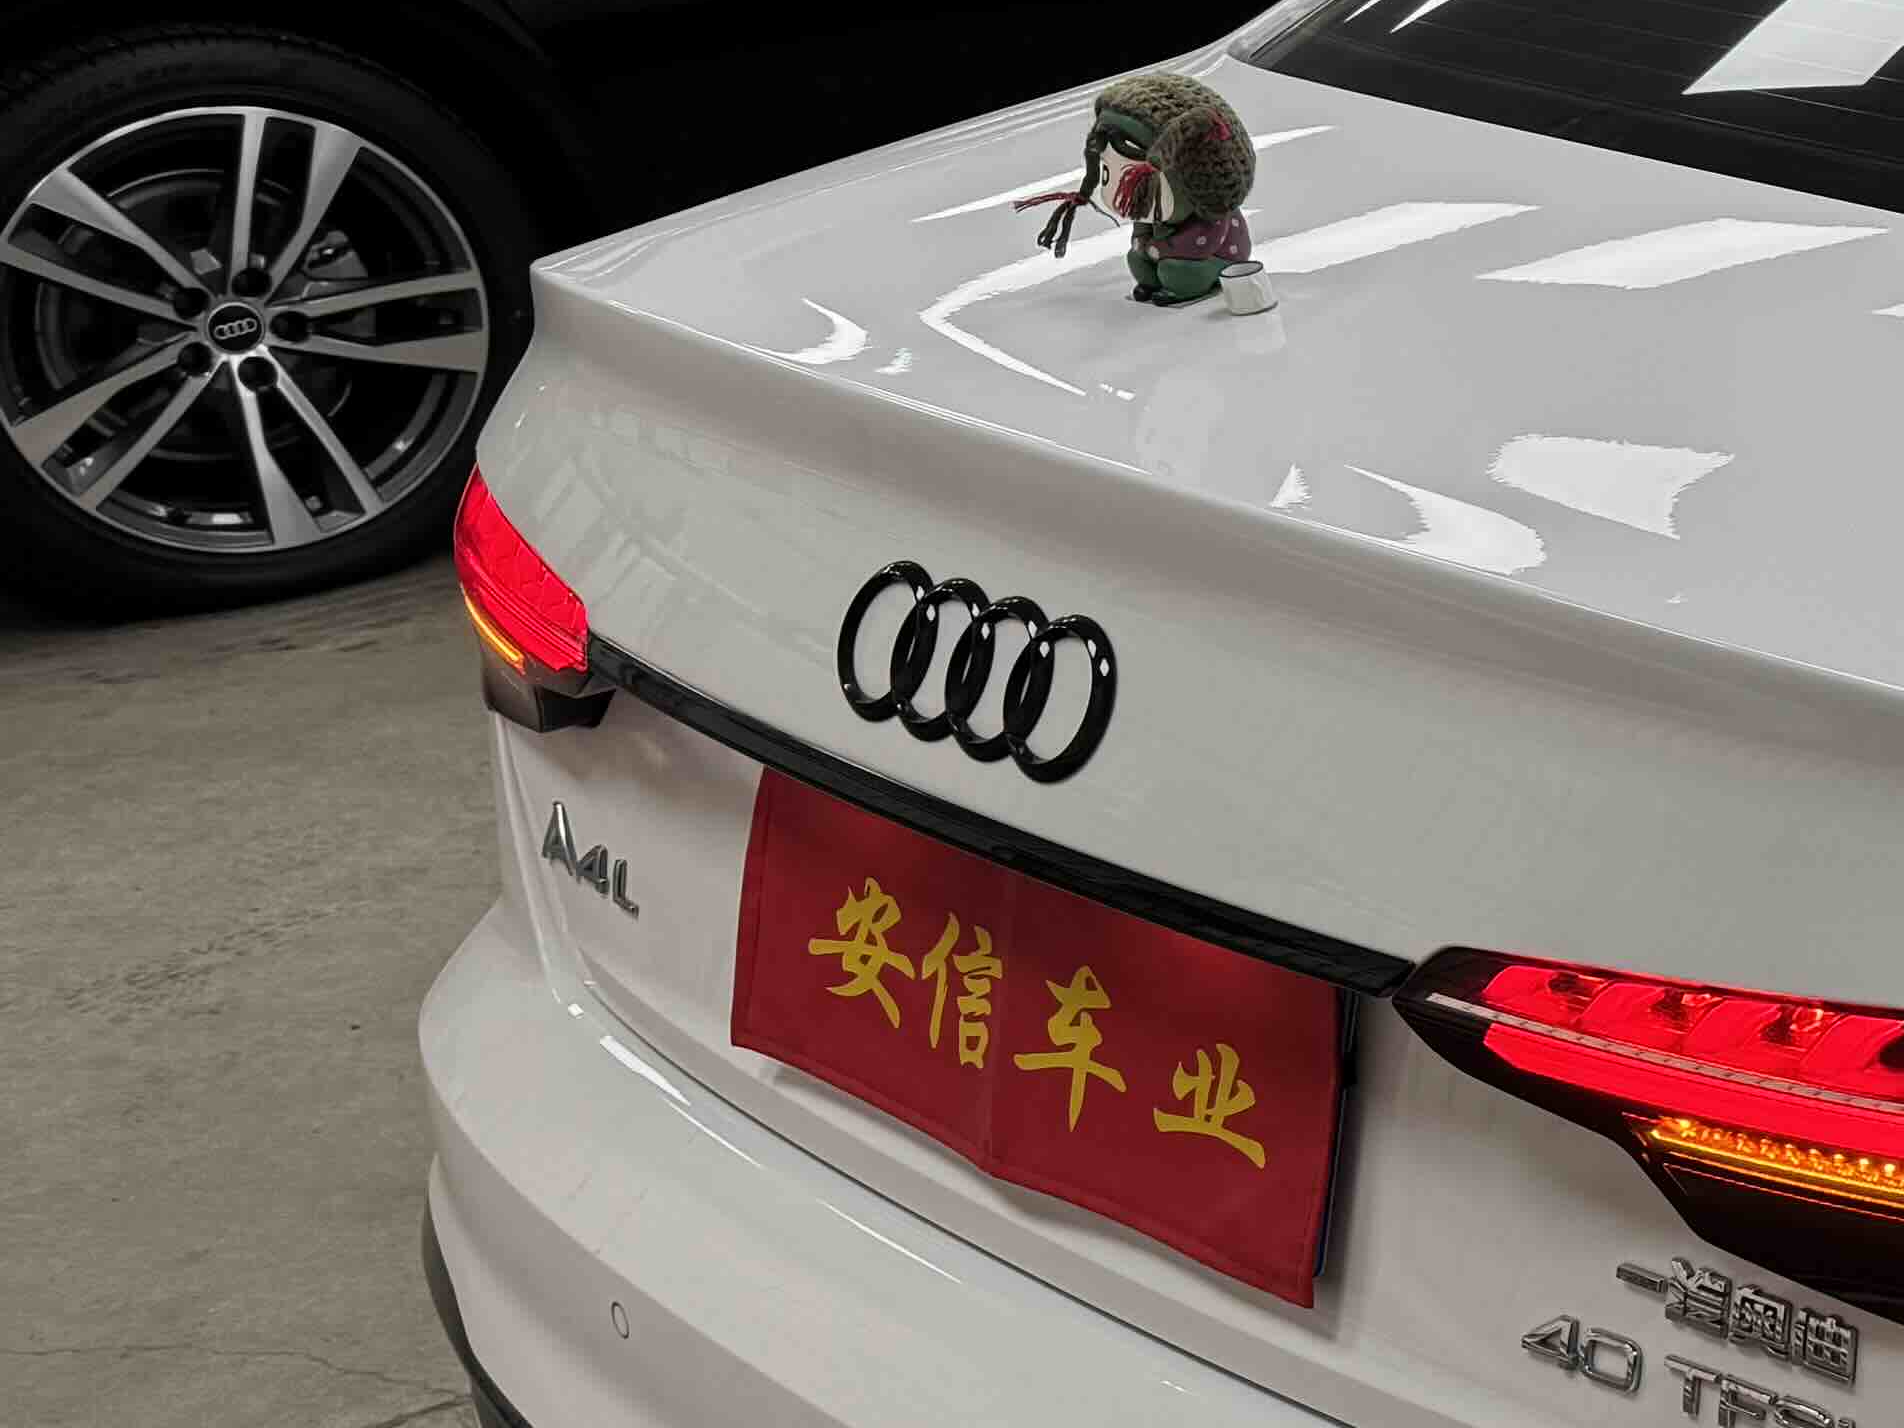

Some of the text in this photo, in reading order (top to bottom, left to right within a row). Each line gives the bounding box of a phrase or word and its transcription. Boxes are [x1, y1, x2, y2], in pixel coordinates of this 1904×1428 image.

[542, 801, 640, 920] A4L
[808, 876, 1266, 1170] 安信车业
[1521, 1314, 1643, 1395] 40
